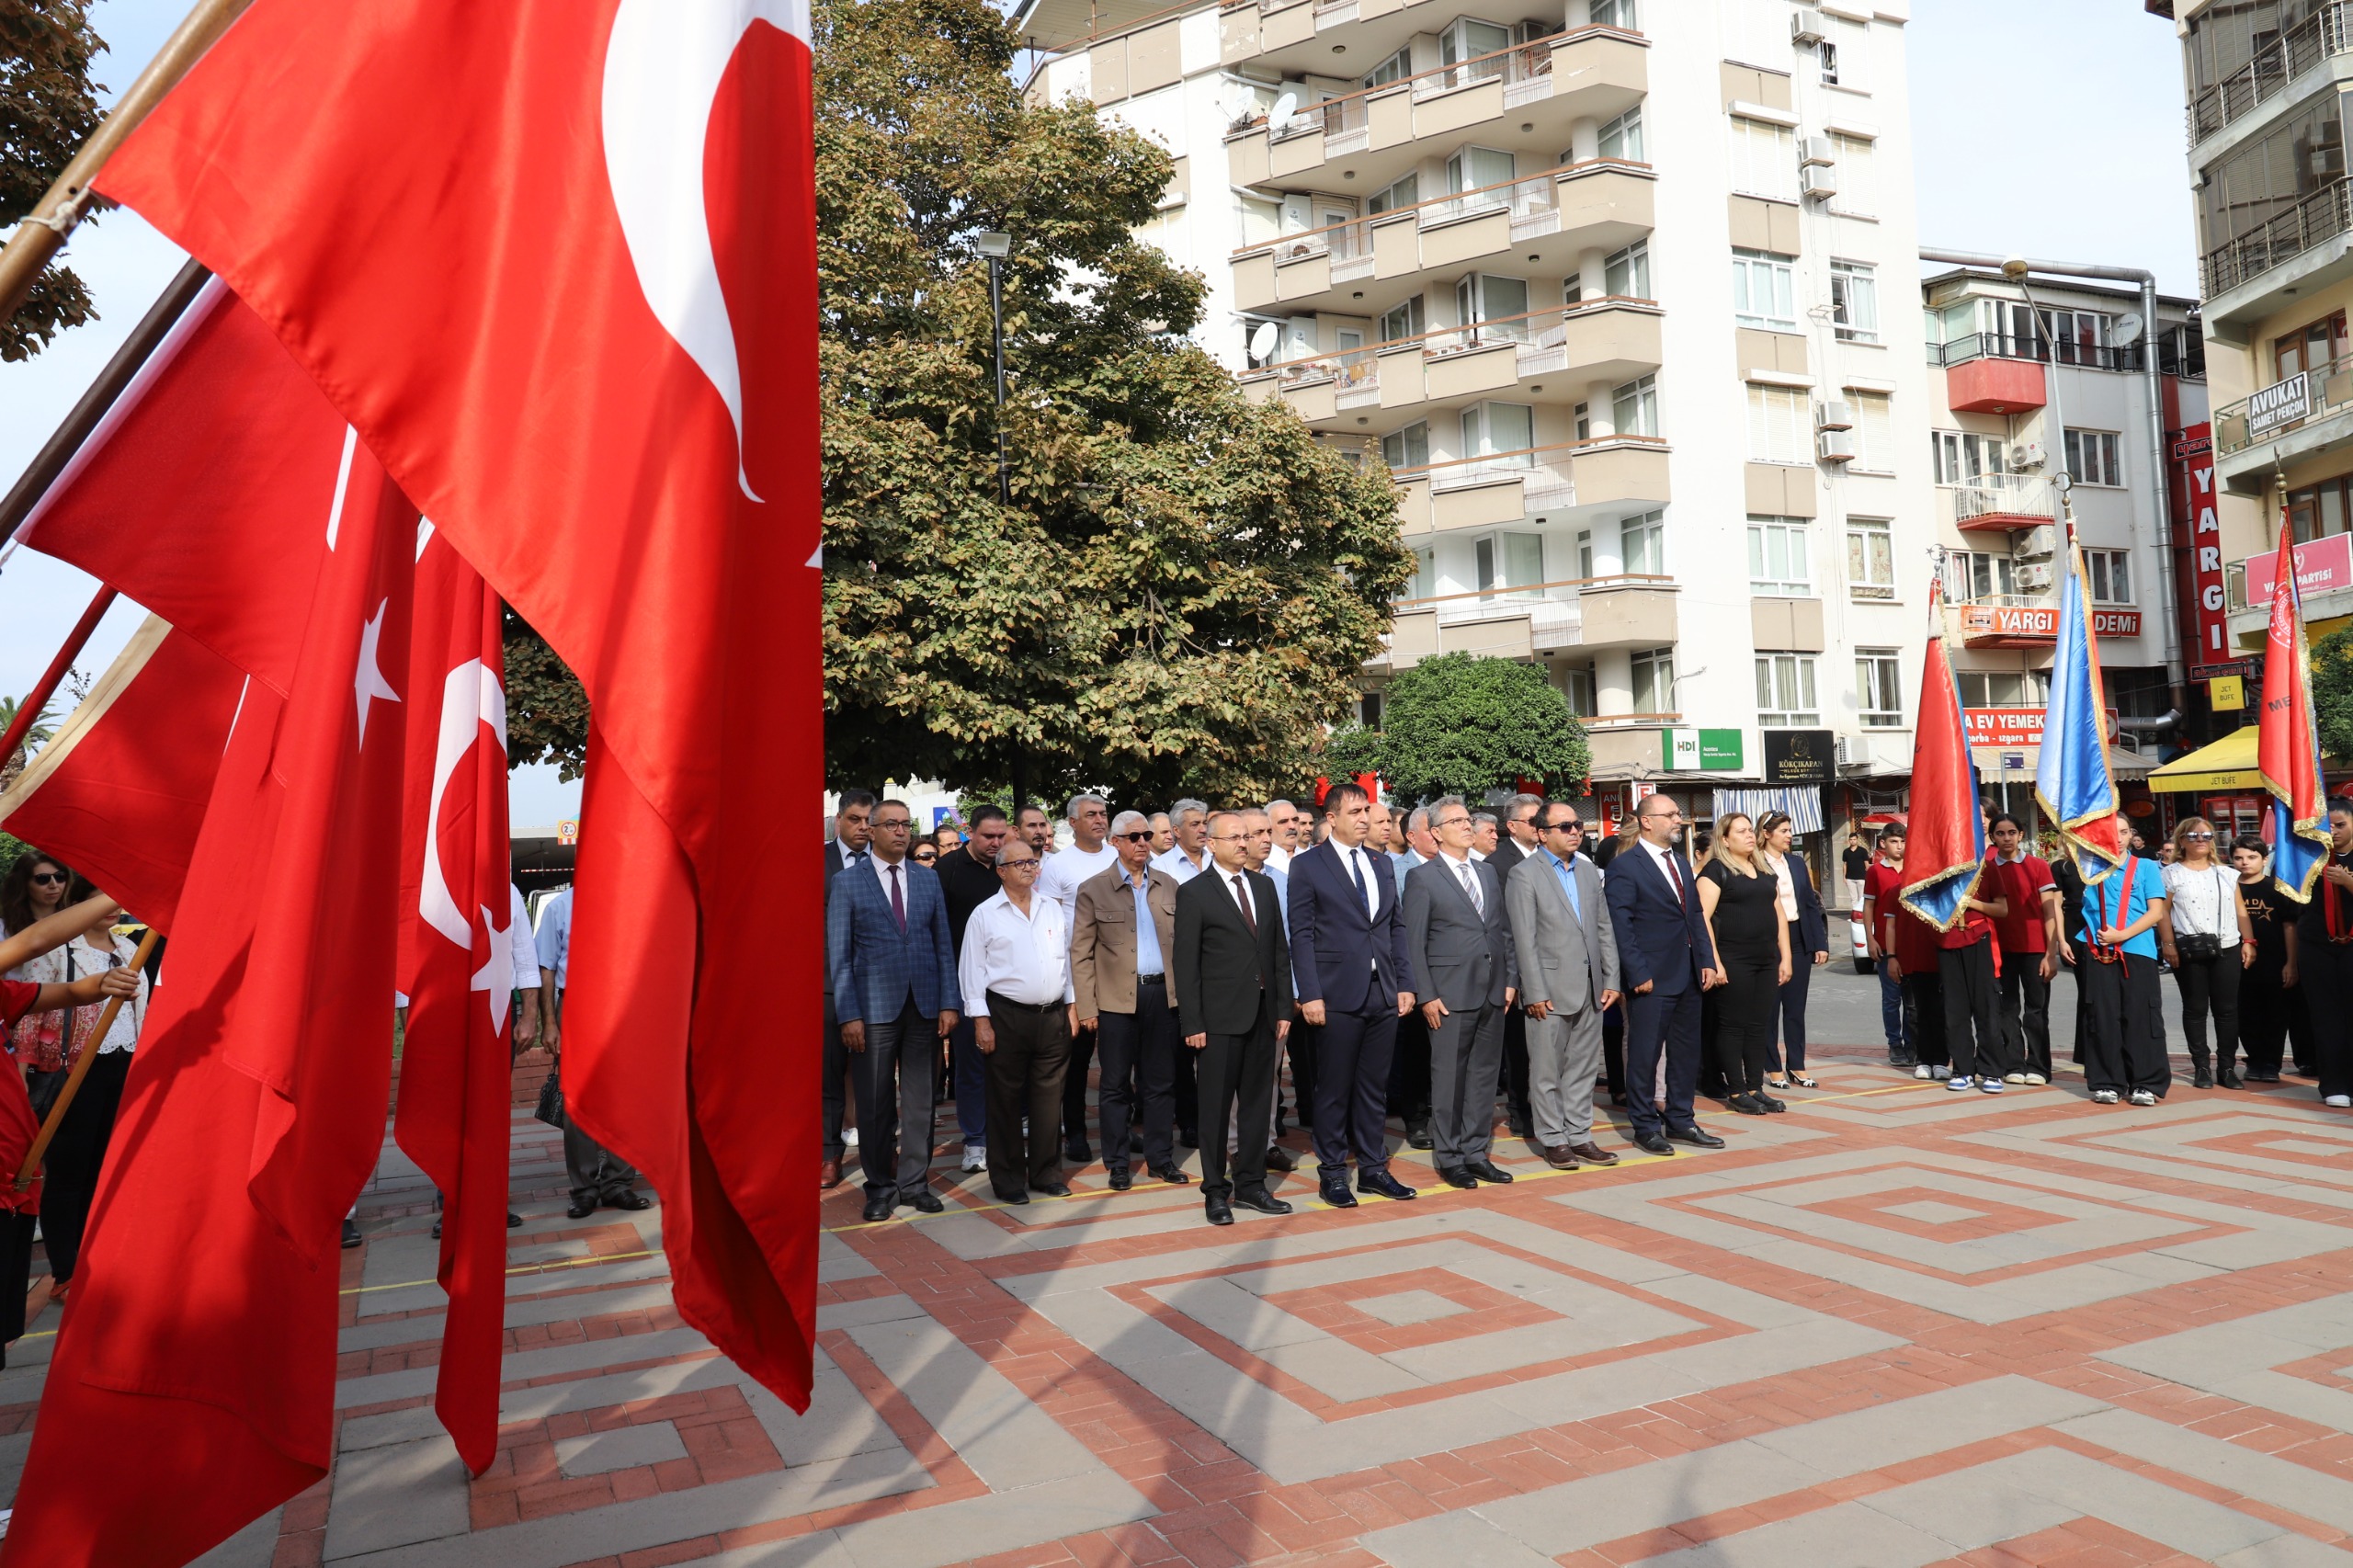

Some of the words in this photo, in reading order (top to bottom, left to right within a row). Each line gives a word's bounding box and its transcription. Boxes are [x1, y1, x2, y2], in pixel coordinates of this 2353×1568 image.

[2252, 376, 2302, 416] AVUKAT
[2253, 410, 2276, 430] SAMET
[2277, 398, 2305, 421] PEKÇOK
[2193, 466, 2223, 650] YARGI
[2264, 581, 2275, 593] VA
[1998, 611, 2052, 631] YARGI
[2220, 693, 2234, 701] BÜFE
[1965, 714, 1974, 729] A
[1976, 714, 1995, 729] EV
[1997, 714, 2046, 729] YEMEK
[1677, 741, 1696, 752] HDI
[2211, 777, 2221, 785] JET
[2222, 776, 2236, 785] BÜFE
